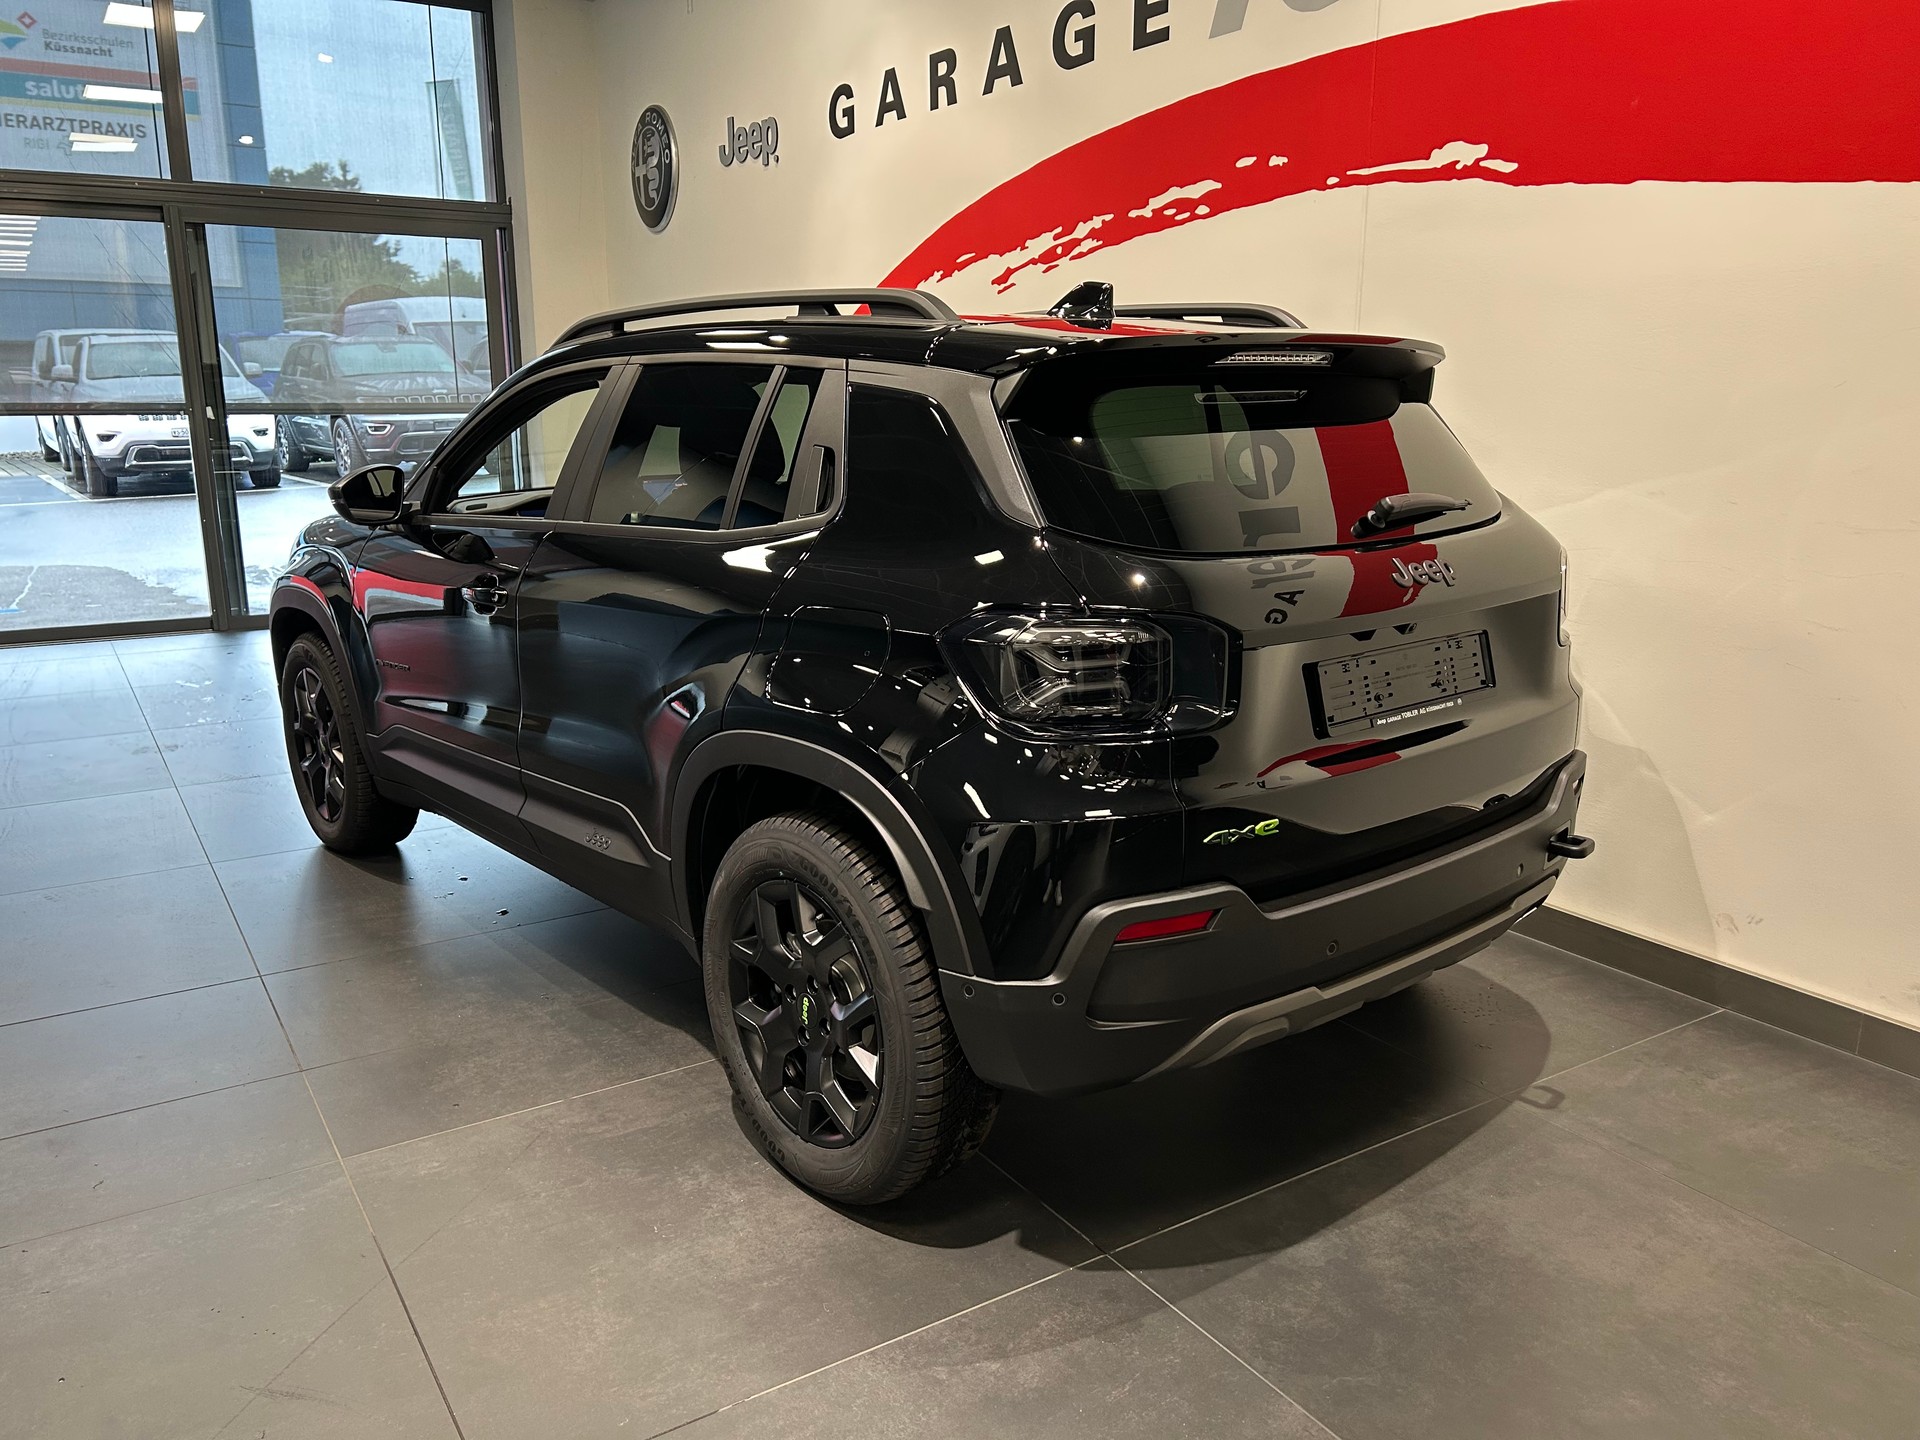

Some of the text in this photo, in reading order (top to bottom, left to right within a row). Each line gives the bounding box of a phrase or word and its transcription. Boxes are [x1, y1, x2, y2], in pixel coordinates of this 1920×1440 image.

[42, 28, 134, 49] Bezirksschulen
[44, 40, 114, 58] Küssnacht
[828, 0, 1170, 139] GARAGE
[25, 79, 101, 101] salut
[645, 111, 671, 164] ROMEO
[718, 116, 777, 167] Jeep
[1392, 557, 1456, 587] Jeep
[1401, 709, 1419, 719] TOBLER
[1419, 706, 1426, 714] AG
